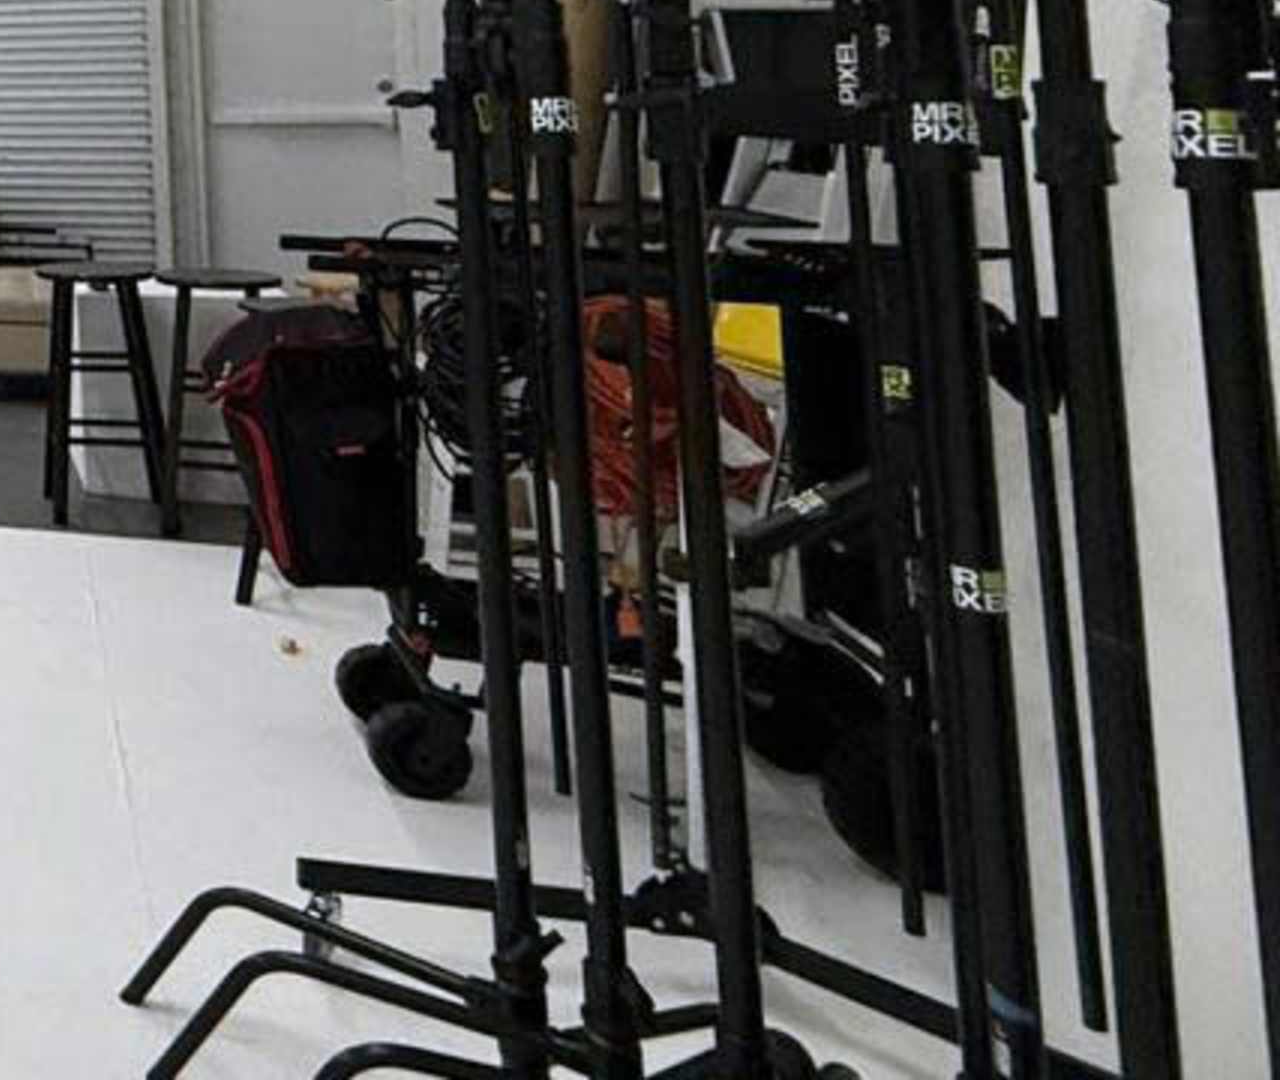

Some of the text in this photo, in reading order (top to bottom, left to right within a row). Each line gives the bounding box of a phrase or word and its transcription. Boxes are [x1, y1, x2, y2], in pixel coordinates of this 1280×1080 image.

[835, 33, 859, 106] PIXEL
[911, 101, 965, 123] MR
[1174, 109, 1203, 133] R
[531, 116, 580, 134] PIX
[912, 122, 981, 146] PIXE
[1173, 133, 1260, 159] IXEL
[949, 563, 979, 590] R
[953, 587, 1007, 612] IXE
